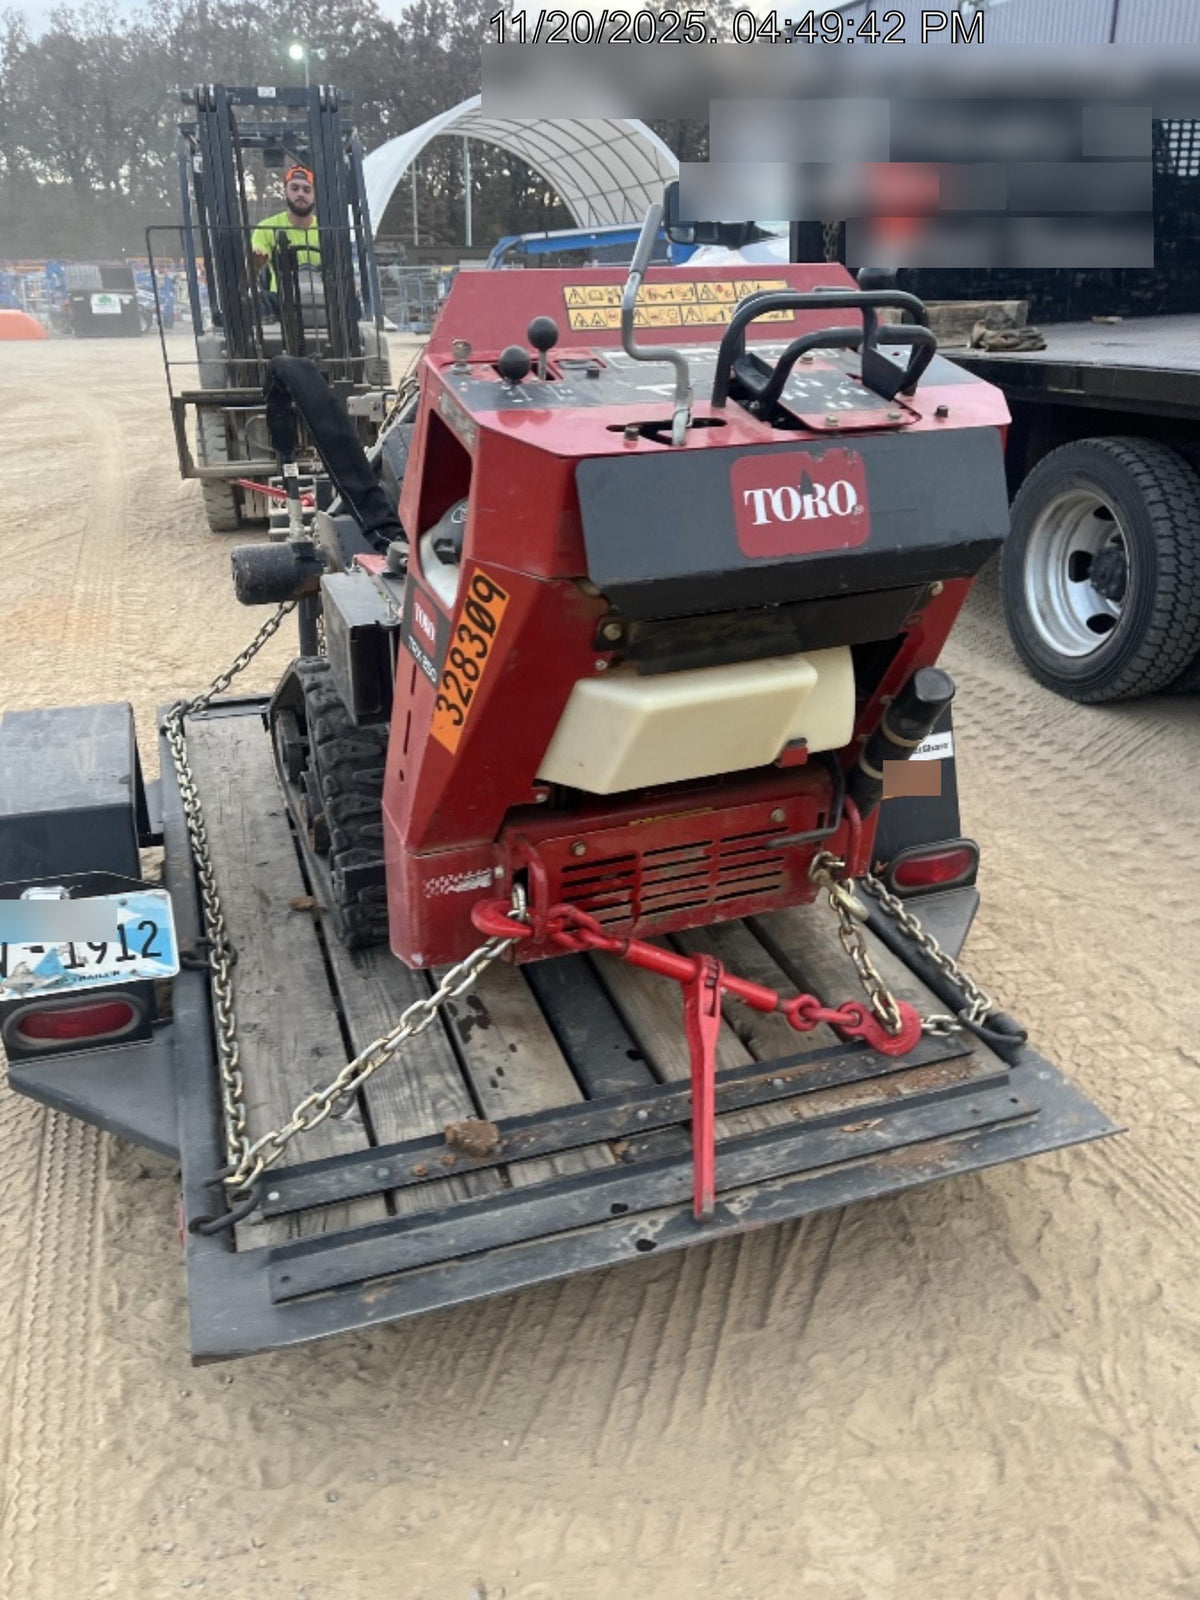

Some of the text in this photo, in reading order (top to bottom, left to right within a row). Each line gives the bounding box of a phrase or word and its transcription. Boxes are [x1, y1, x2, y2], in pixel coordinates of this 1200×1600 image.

[743, 480, 858, 526] TORO
[413, 601, 437, 643] TORO
[436, 574, 507, 727] 328309
